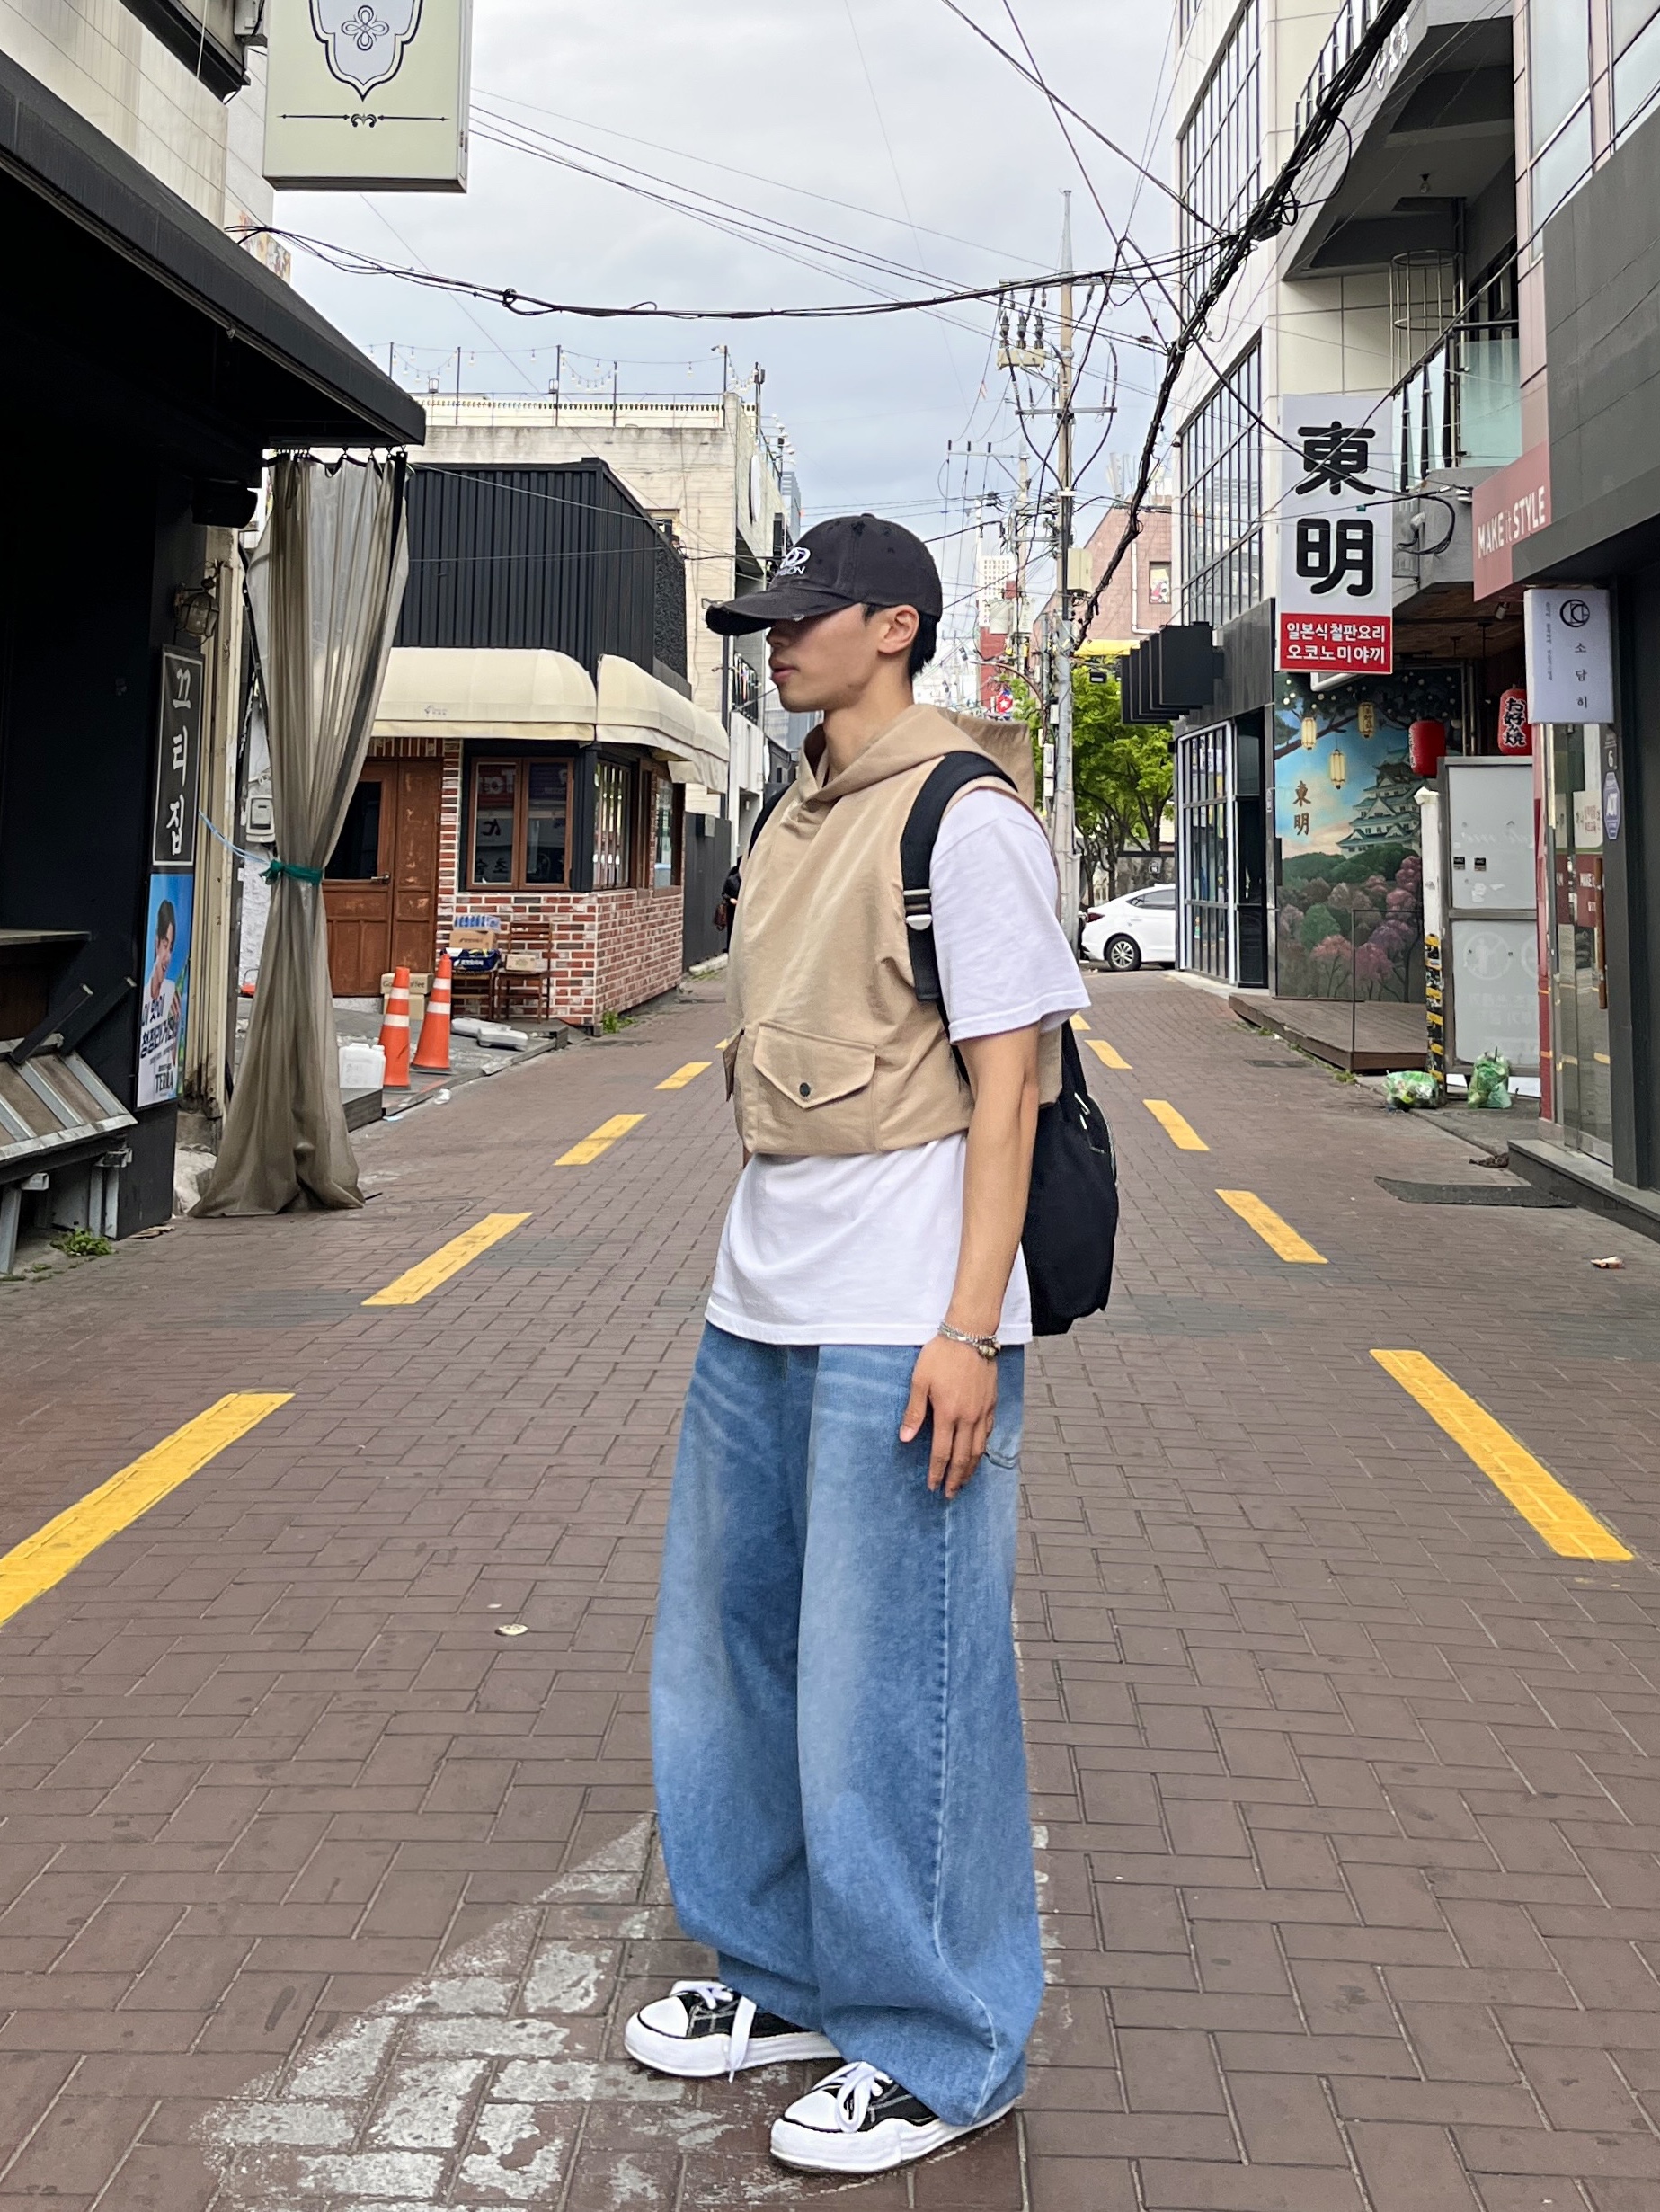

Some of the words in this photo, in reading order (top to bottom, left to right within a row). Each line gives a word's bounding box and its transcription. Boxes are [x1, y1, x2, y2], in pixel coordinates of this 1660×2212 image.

[1295, 421, 1375, 597] 東明
[1478, 512, 1505, 559] MAKE
[1513, 485, 1546, 539] STYLE
[1286, 644, 1385, 665] 오코노미야끼
[1292, 780, 1311, 836] 東明
